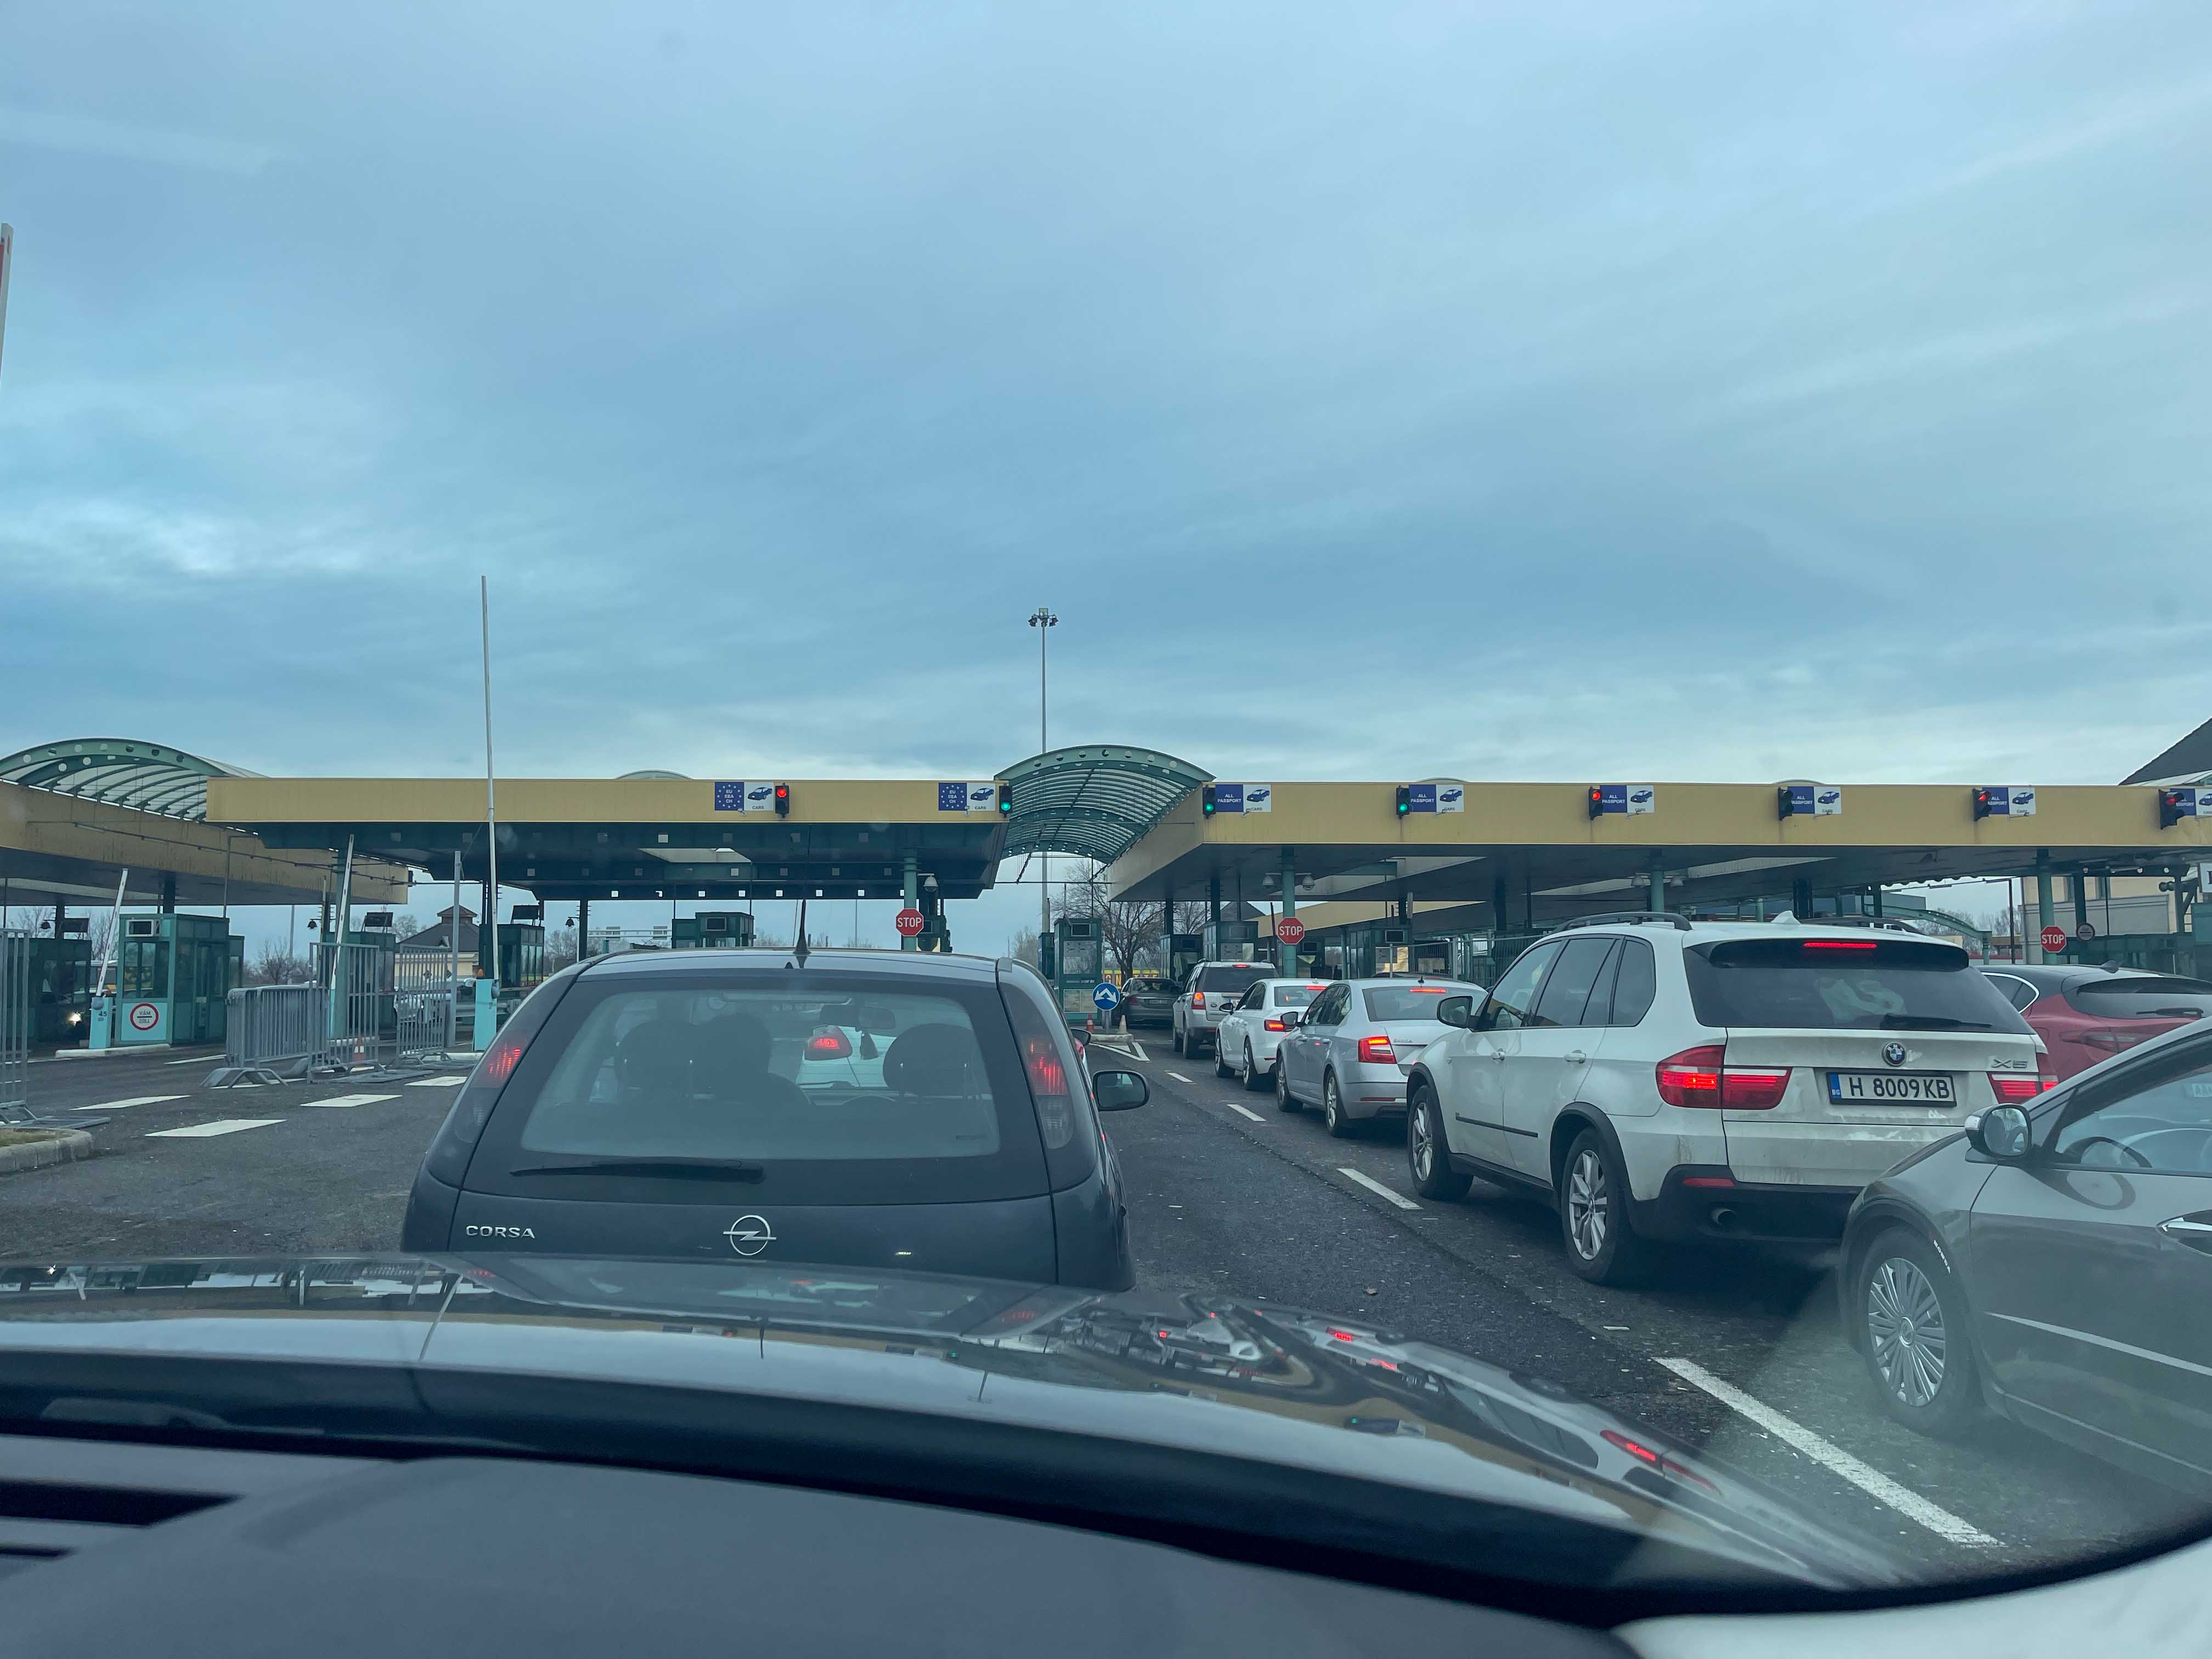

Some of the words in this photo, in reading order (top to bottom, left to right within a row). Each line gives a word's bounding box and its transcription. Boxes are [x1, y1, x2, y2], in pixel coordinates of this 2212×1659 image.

[898, 917, 922, 927] STOP
[1279, 926, 1302, 935] STOP
[2041, 934, 2064, 944] STOP
[1991, 1059, 2028, 1069] X5
[1849, 1077, 1864, 1097] H
[466, 1225, 535, 1239] CORSA
